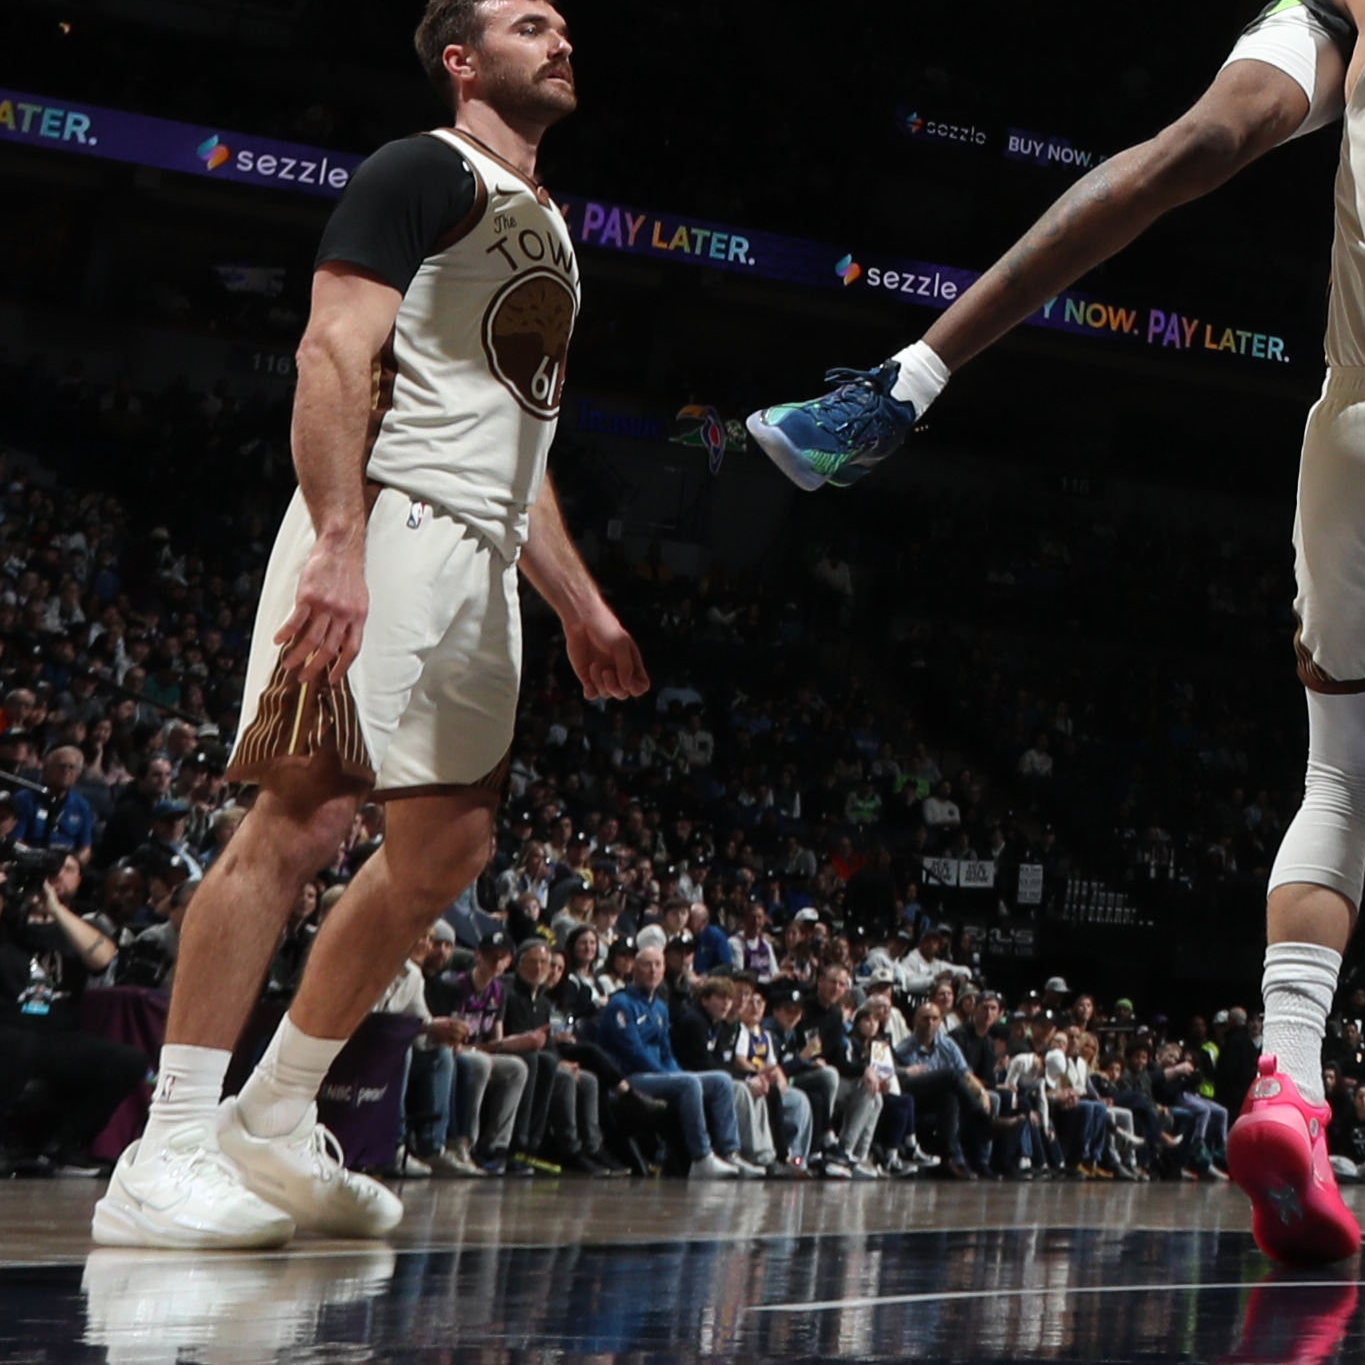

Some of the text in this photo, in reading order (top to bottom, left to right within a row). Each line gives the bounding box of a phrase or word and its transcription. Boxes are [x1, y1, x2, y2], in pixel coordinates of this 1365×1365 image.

[0, 99, 349, 189] ATER. sezzle
[1008, 135, 1044, 158] BUY
[1047, 143, 1094, 168] NOW.
[494, 214, 516, 233] The
[486, 229, 573, 273] TOW
[581, 202, 646, 248] PAY
[651, 220, 757, 266] LATER.
[865, 266, 958, 301] sezzle
[1064, 297, 1139, 335] NOW.
[1147, 308, 1199, 349] PAY
[1204, 324, 1290, 363] LATER.
[531, 355, 560, 406] 61
